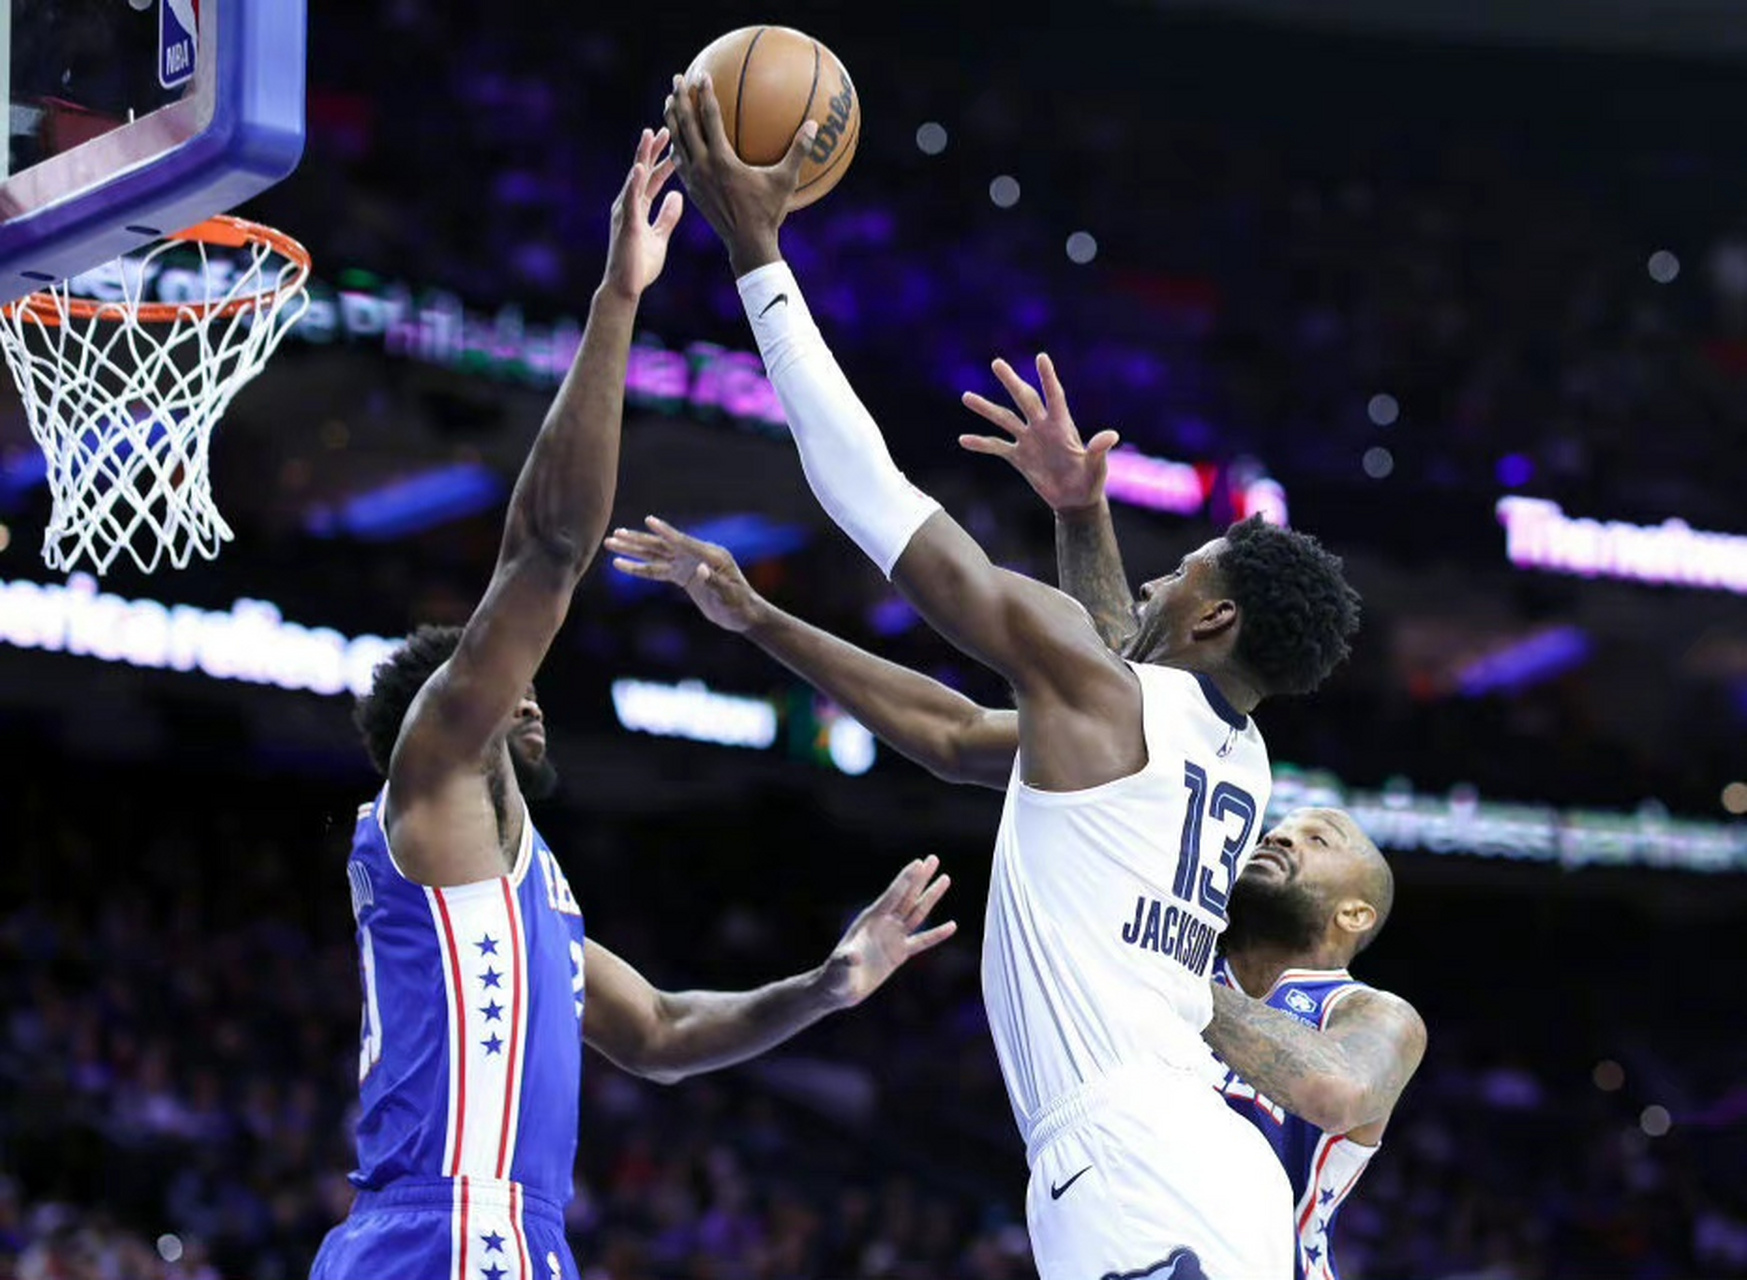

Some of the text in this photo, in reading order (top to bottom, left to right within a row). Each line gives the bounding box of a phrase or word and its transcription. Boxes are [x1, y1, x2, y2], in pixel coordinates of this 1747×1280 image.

[166, 39, 189, 76] NBA
[811, 66, 852, 165] Wilso
[1172, 759, 1257, 922] 13
[1122, 895, 1217, 977] JACKSON
